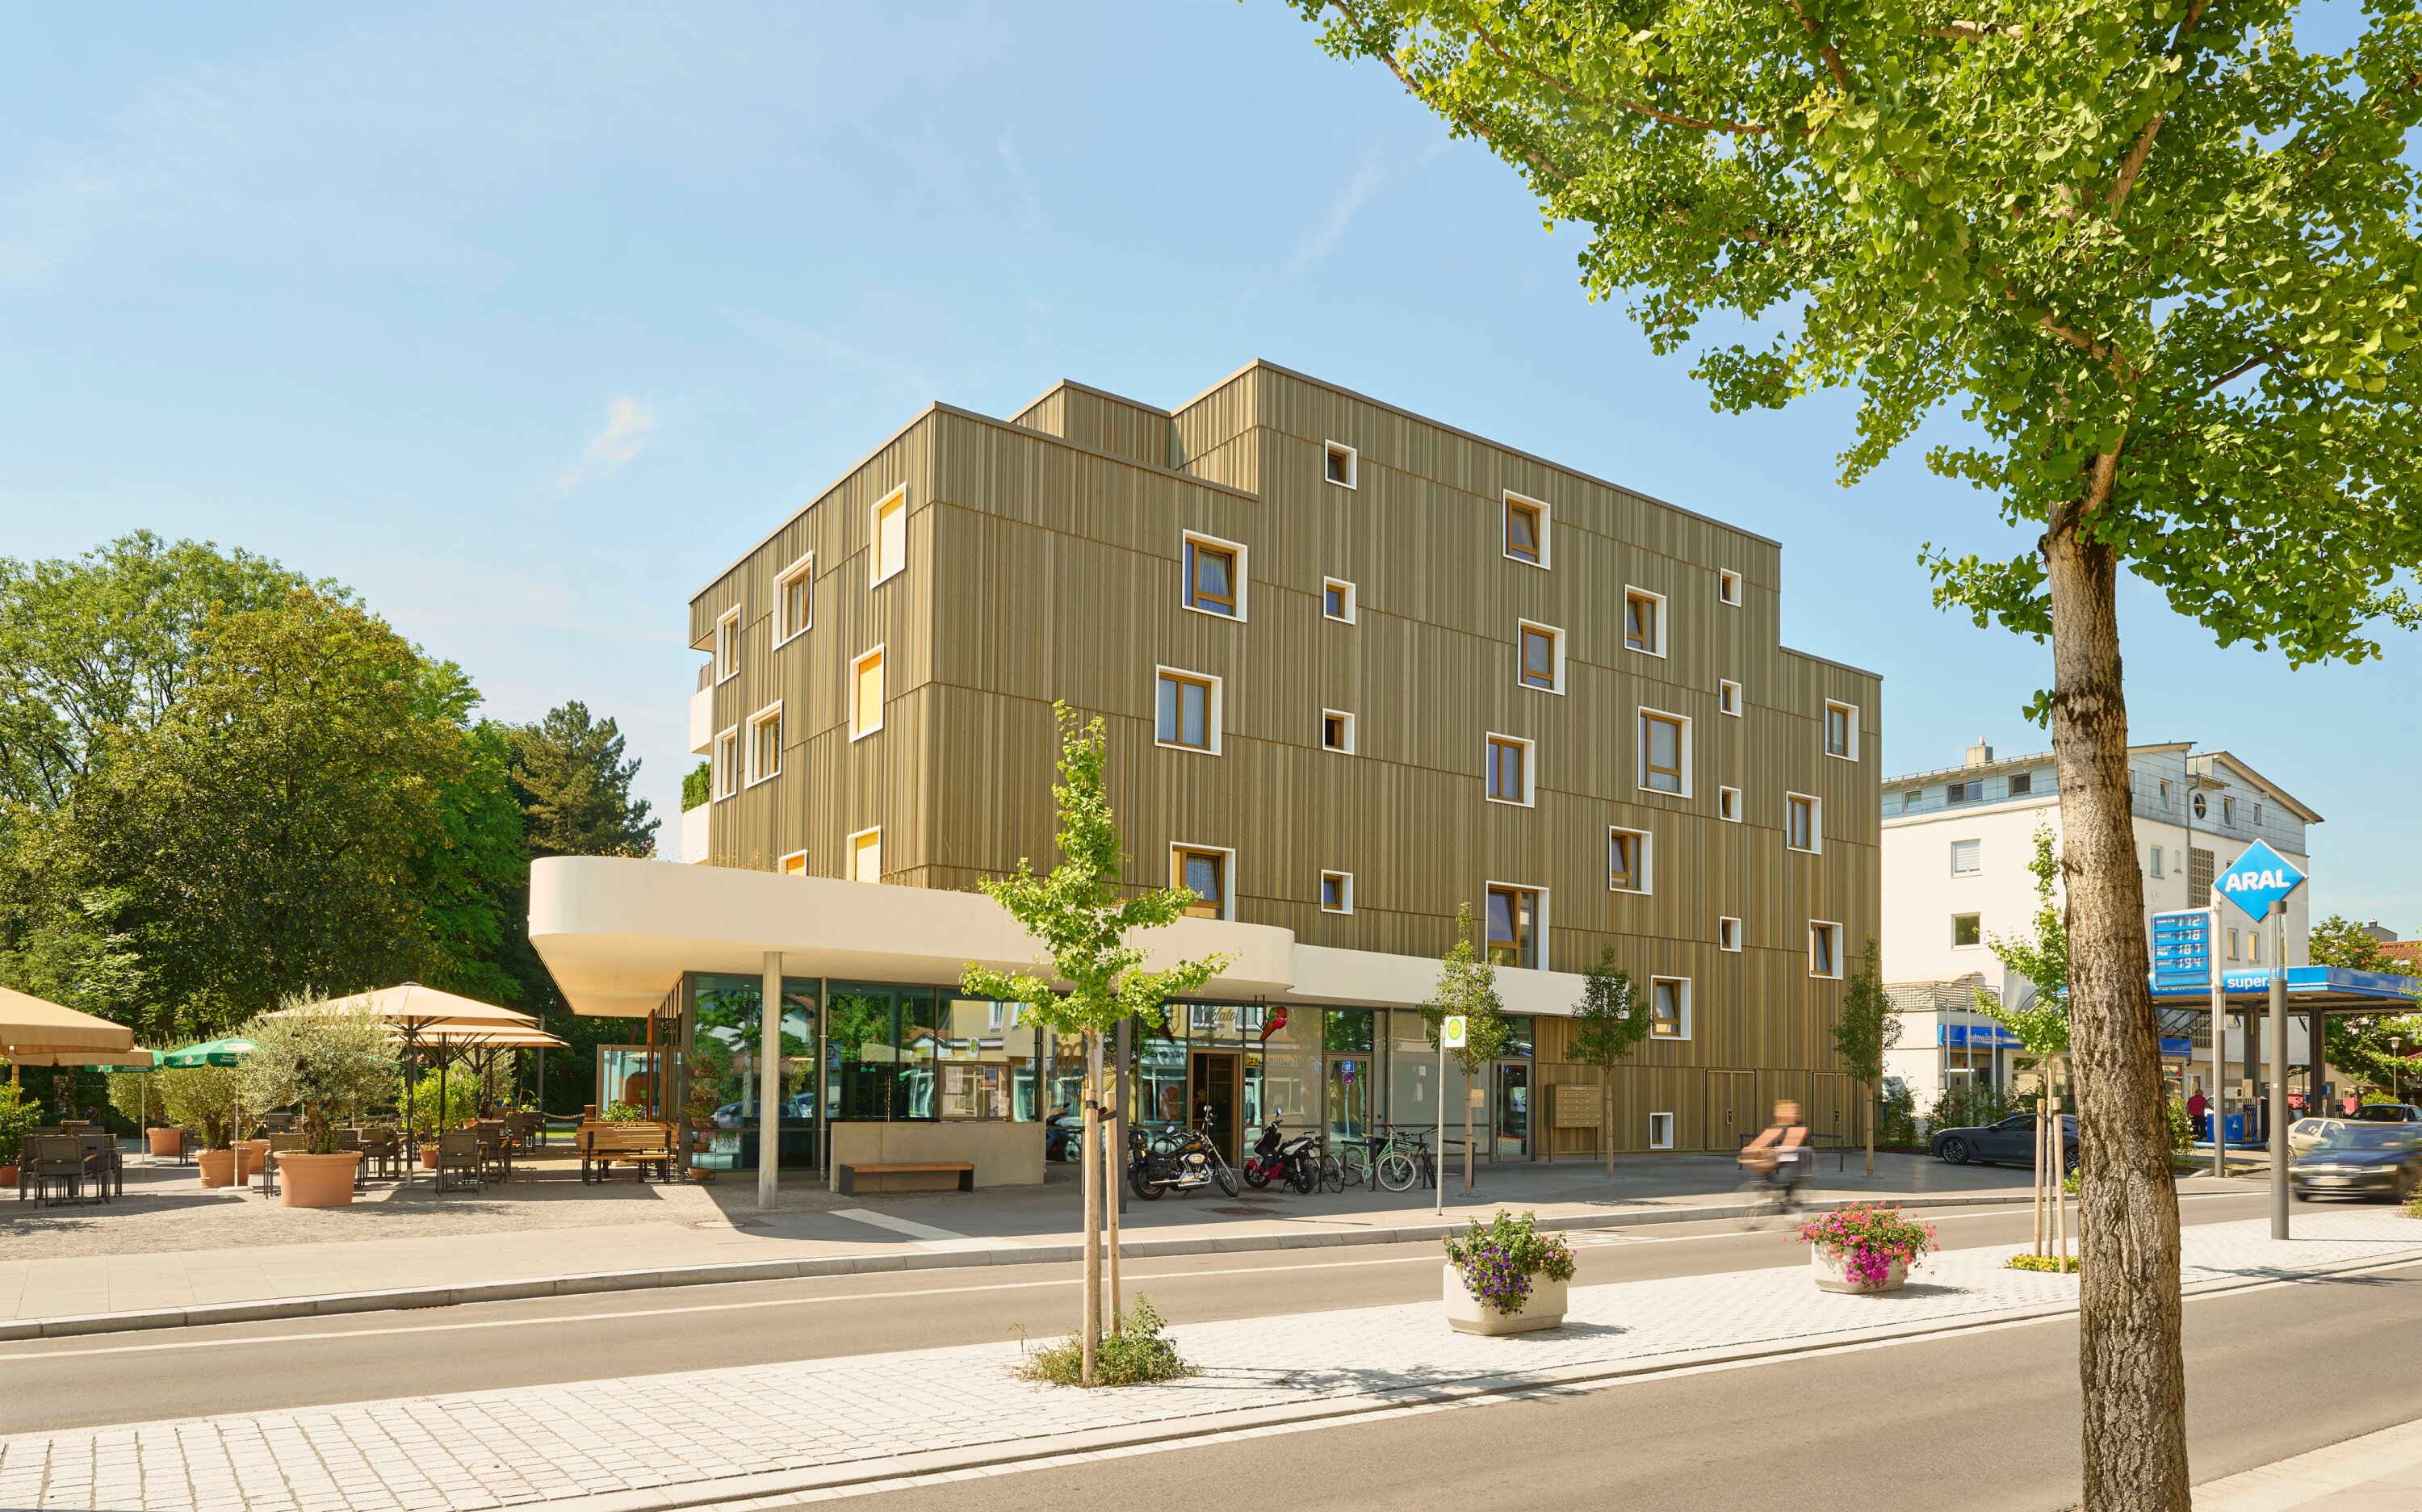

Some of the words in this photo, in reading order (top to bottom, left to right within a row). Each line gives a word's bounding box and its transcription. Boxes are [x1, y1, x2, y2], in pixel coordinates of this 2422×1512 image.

[2225, 869, 2290, 892] ARAL
[2178, 929, 2200, 940] 178
[2179, 943, 2200, 954] 187
